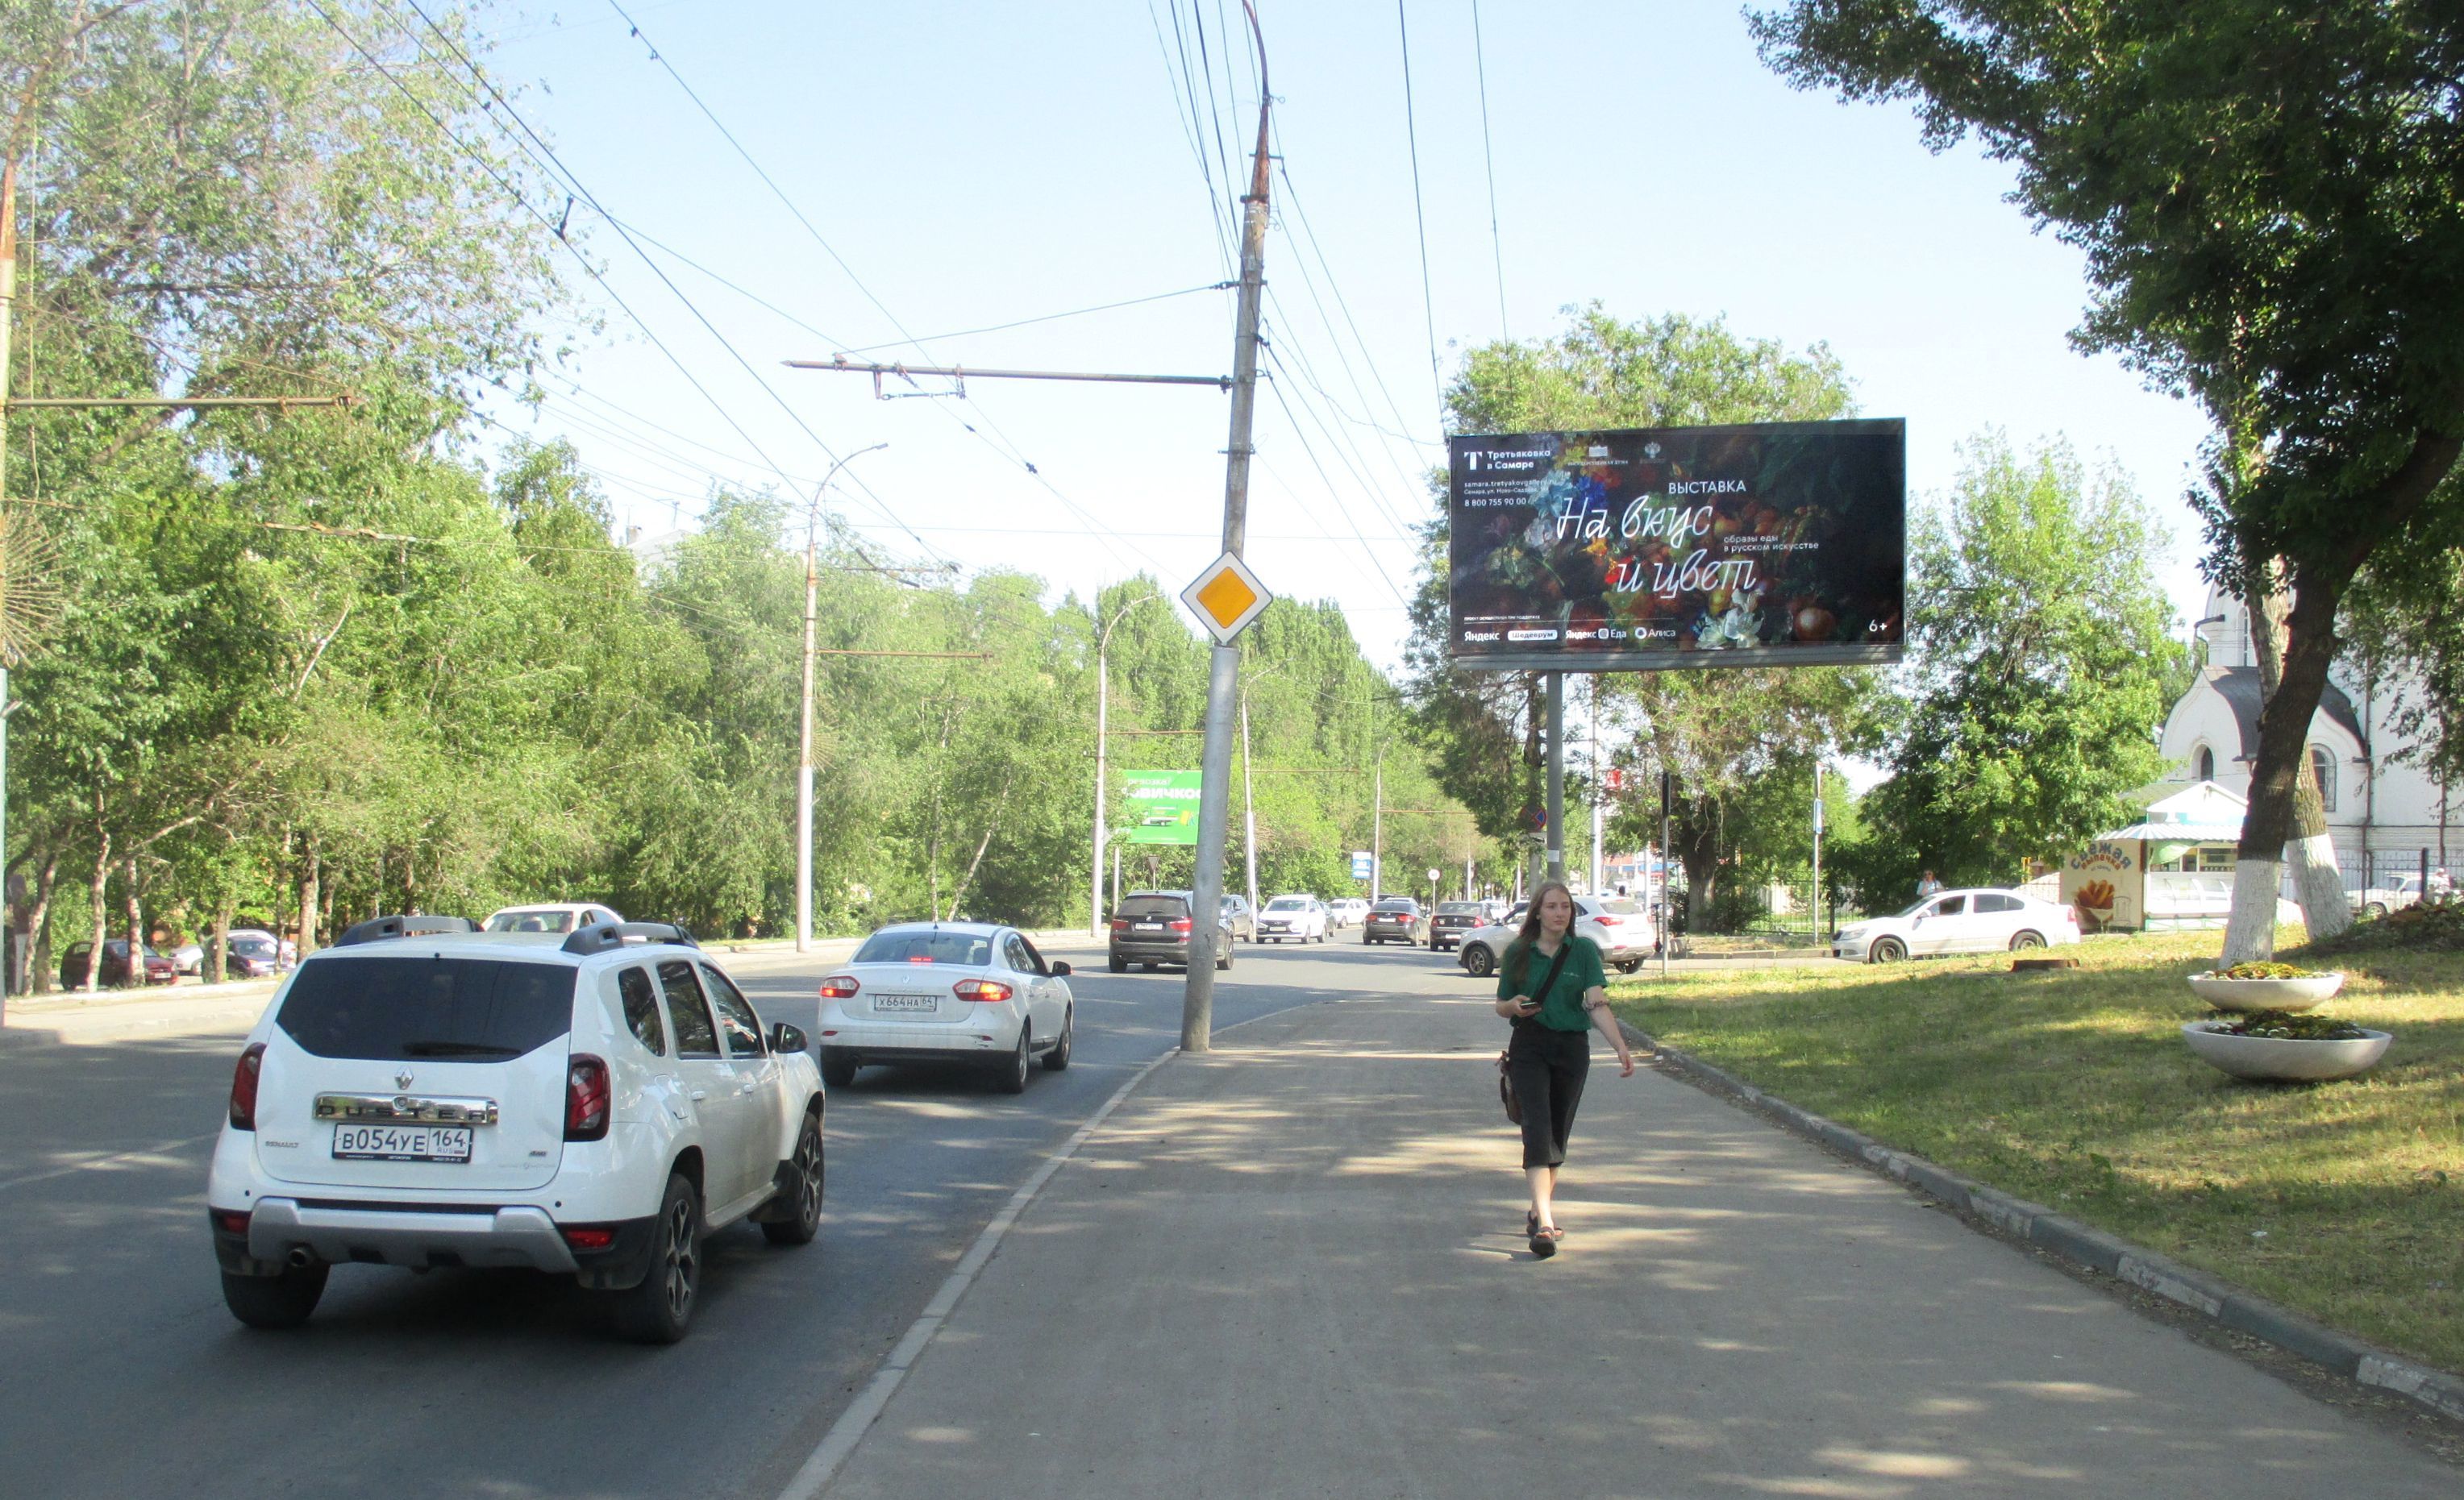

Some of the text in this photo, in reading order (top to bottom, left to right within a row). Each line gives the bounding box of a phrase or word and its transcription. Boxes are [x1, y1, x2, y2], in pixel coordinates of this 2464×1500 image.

[1487, 450, 1550, 460] Третьяковка
[1495, 460, 1534, 471] Самаре
[1668, 480, 1747, 495] ВЫСТАВКА
[1464, 499, 1470, 507] 8
[1471, 498, 1487, 506] 800
[1489, 498, 1502, 506] 755
[1516, 497, 1526, 505] 00
[1556, 494, 1714, 549] На вкус
[1724, 535, 1758, 544] образы
[1731, 544, 1770, 554] русском
[1772, 542, 1819, 552] искусстве
[1617, 548, 1757, 599] и цвет
[1869, 619, 1888, 632] 6+
[1464, 631, 1500, 642] Яндекс
[1512, 632, 1554, 640] Шедеврум
[1565, 629, 1627, 640] Яндекс Еда
[1648, 629, 1676, 638] Алиса
[318, 1105, 485, 1122] DUSTER
[432, 1130, 464, 1147] 164
